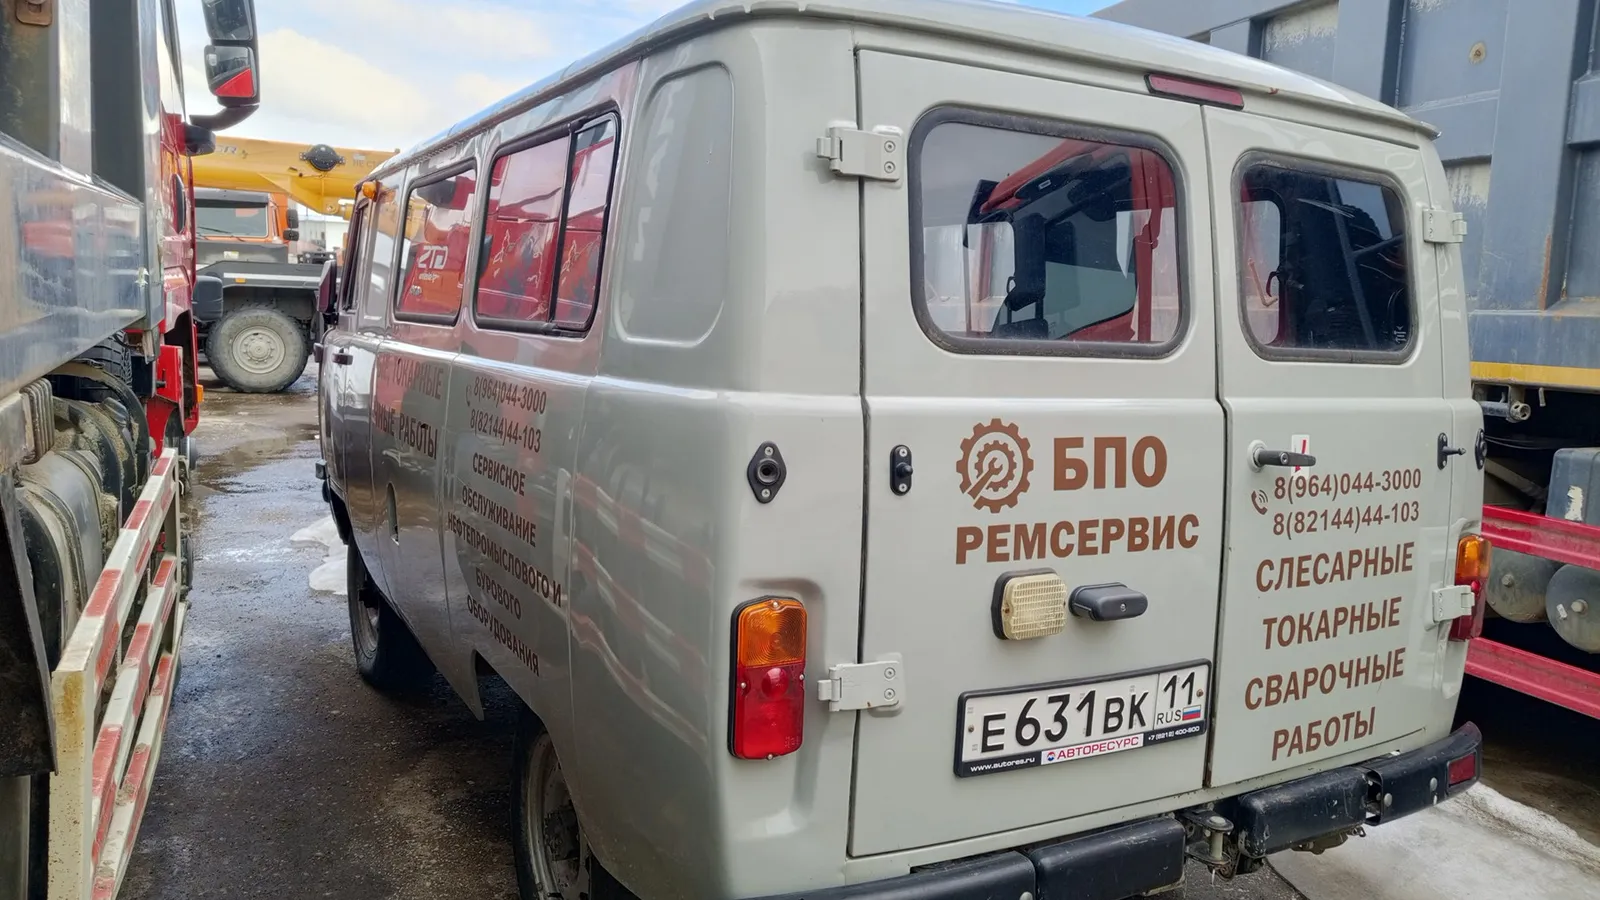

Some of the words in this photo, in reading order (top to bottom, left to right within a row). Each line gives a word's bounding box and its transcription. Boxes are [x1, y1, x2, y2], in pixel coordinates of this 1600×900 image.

[392, 355, 444, 399] ТОКАРНЫЕ
[473, 376, 547, 414] 8(964)044-3000
[399, 412, 438, 460] РАБОТЫ
[470, 408, 541, 453] 8(82144)44-103
[472, 452, 526, 497] СЕРВИСНОЕ
[1053, 435, 1168, 491] БПО
[1274, 468, 1422, 505] 8(964)044-3000
[462, 485, 537, 548] ОБСЛУЖИВАНИЕ
[955, 513, 1200, 565] РЕМСЕРВИС
[1272, 501, 1420, 540] 8(82144)44-103
[448, 512, 550, 599] НЕФТЕПРОМЫСЛОВОГО
[553, 579, 562, 608] И
[1255, 541, 1415, 593] СЛЕСАРНЫЕ
[475, 567, 522, 620] БУРОВОГО
[467, 594, 540, 677] ОБОРУДОВАНИЯ
[1262, 596, 1402, 650] ТОКАРНЫЕ
[1162, 671, 1197, 709] 11
[1244, 647, 1407, 711] СВАРОЧНЫЕ
[1156, 709, 1182, 725] RUS
[1271, 706, 1376, 762] РАБОТЫ
[1057, 736, 1140, 760] АВТОРЕСУРС
